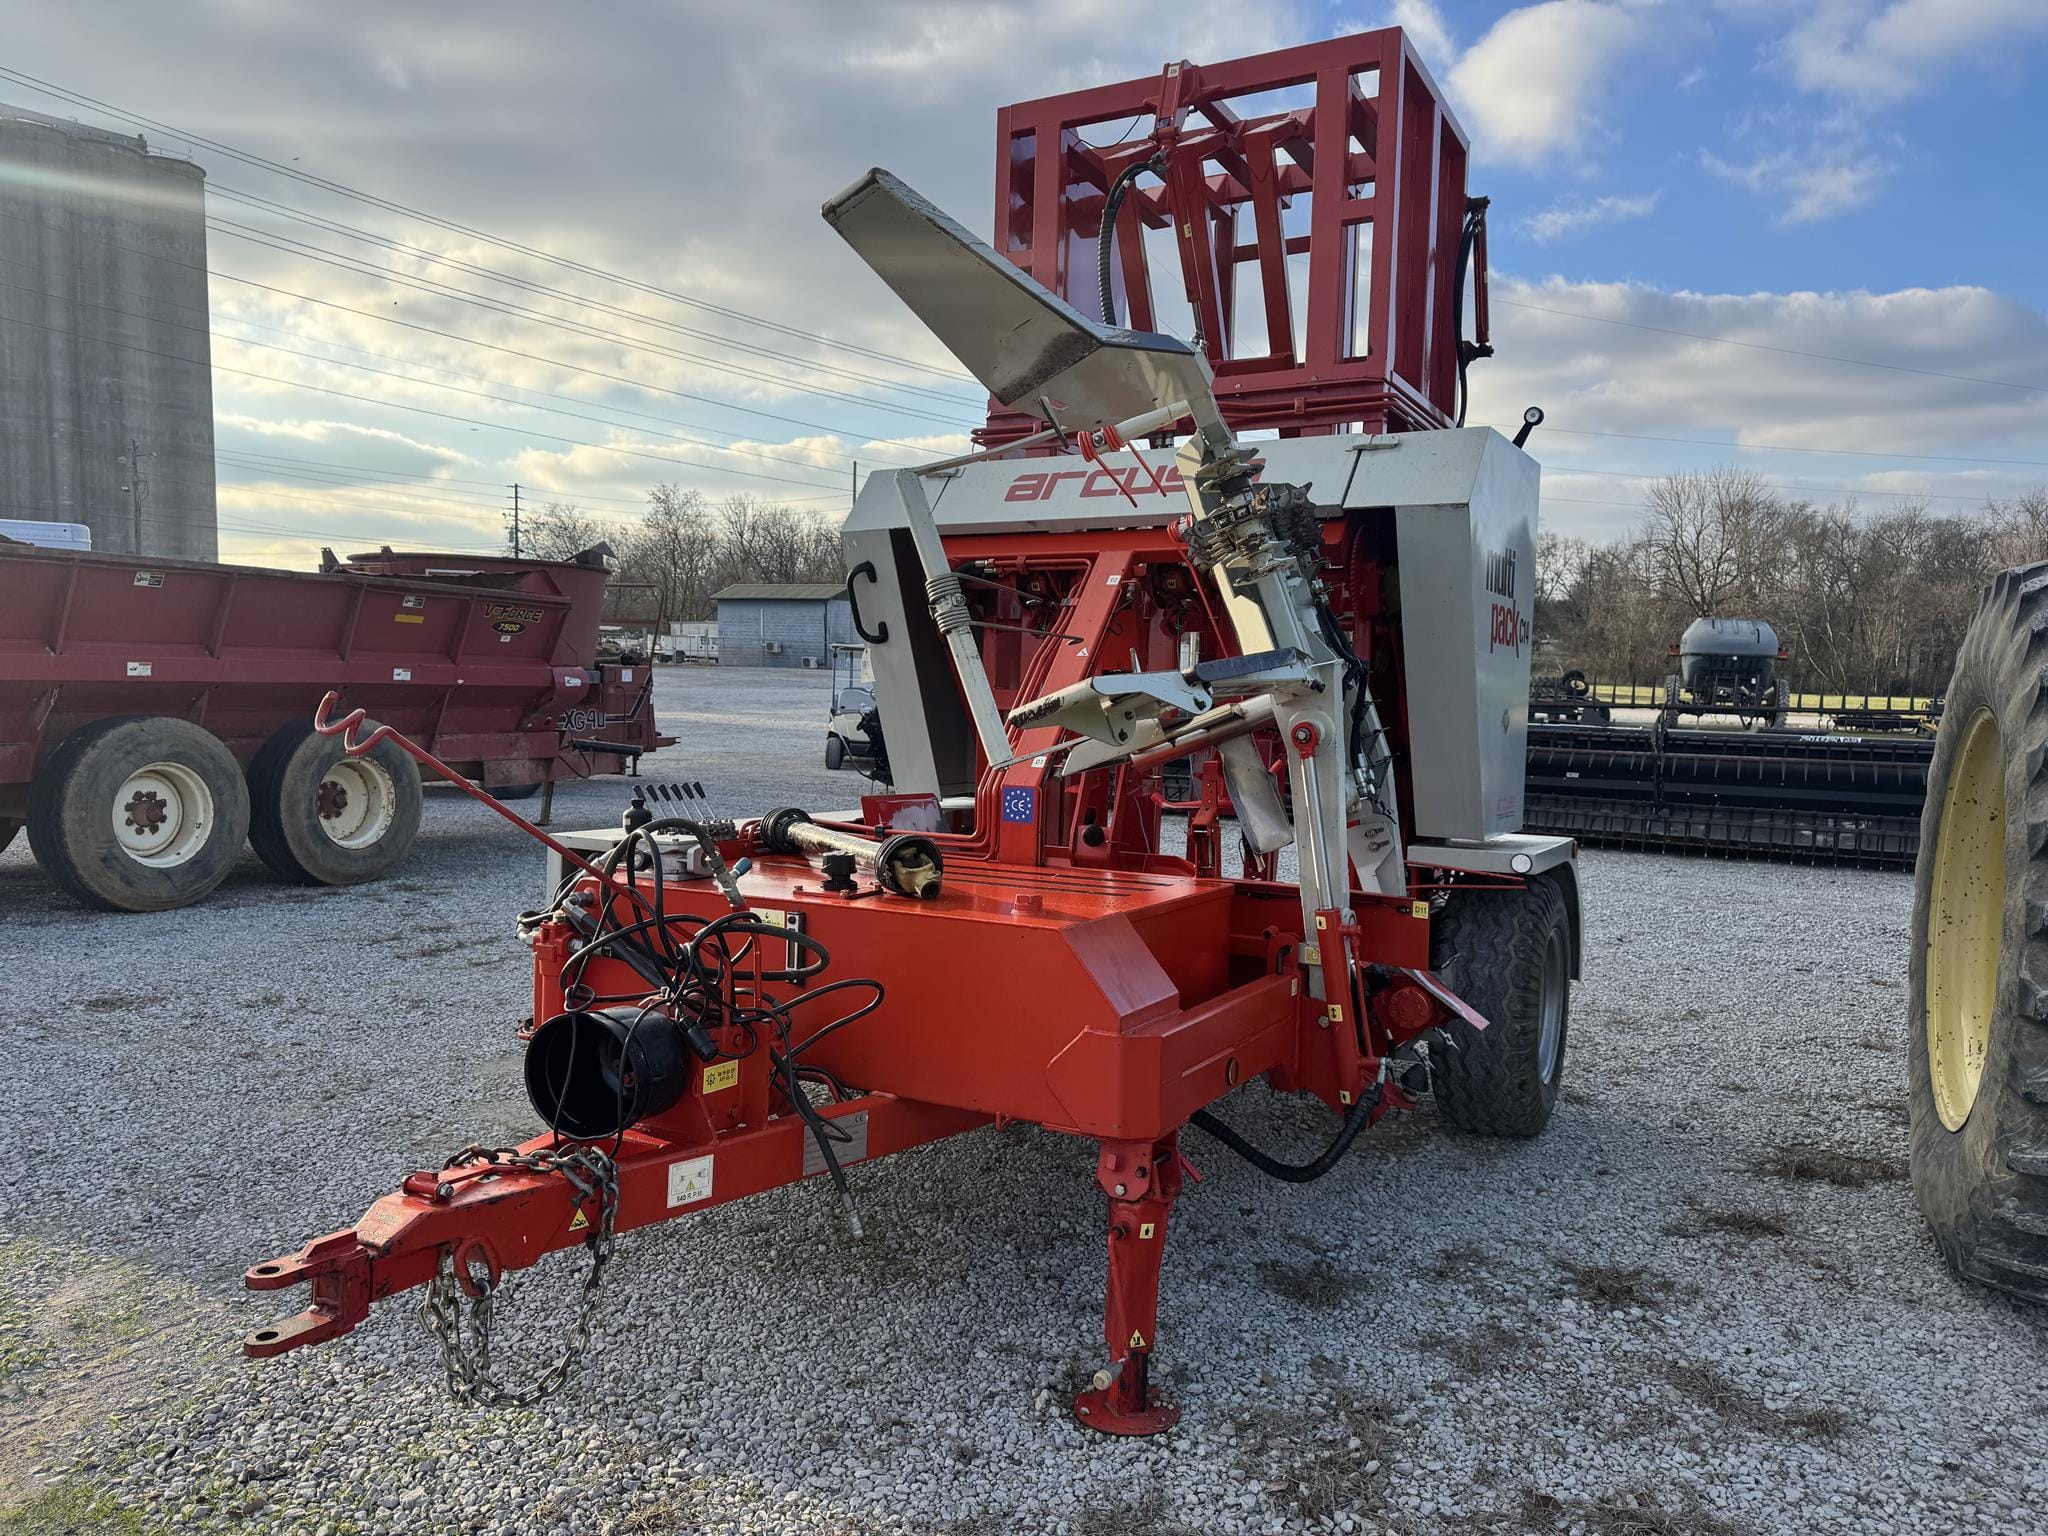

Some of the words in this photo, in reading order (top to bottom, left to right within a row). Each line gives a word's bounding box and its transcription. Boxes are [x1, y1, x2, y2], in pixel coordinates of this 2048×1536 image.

[1485, 547, 1517, 599] multi
[498, 623, 520, 631] 7500
[1490, 600, 1520, 659] pack
[1519, 618, 1530, 645] C14
[1011, 799, 1025, 811] CE
[1414, 905, 1427, 915] D11
[676, 1194, 687, 1203] 540
